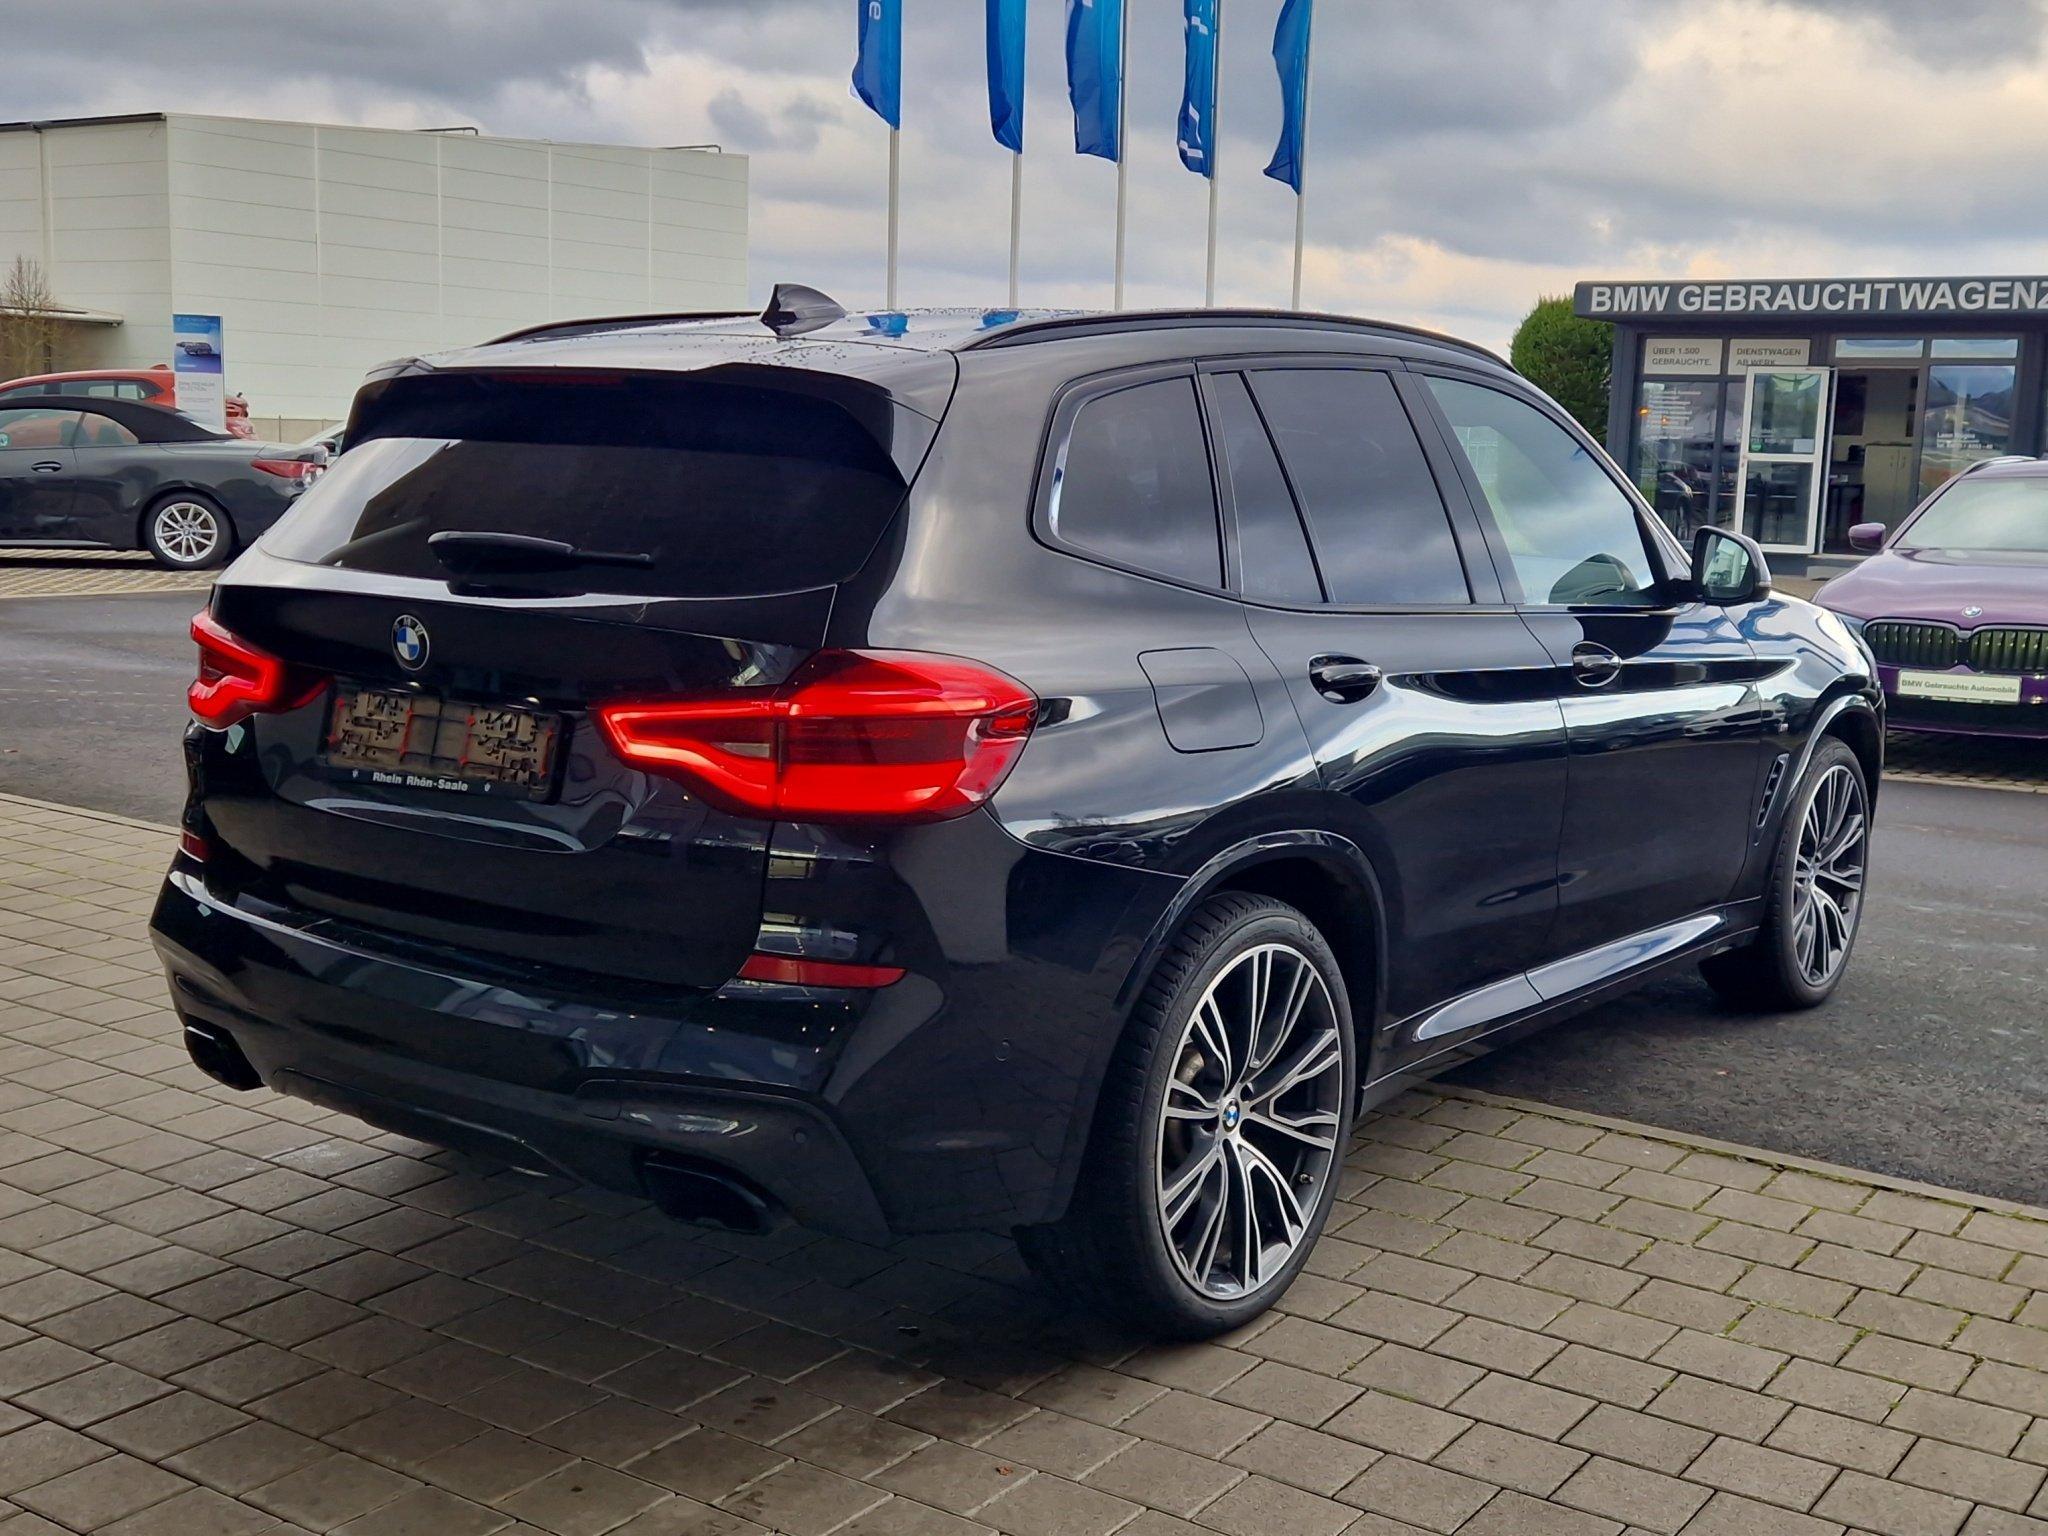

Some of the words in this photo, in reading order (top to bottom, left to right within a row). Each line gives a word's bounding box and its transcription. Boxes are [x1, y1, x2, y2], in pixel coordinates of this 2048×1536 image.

[1590, 286, 1671, 312] BMW
[1653, 346, 1675, 355] ÜBER
[1678, 347, 1700, 355] 1.500
[1736, 348, 1801, 356] DIENSTWAGEN
[1901, 679, 1924, 688] BMW
[1924, 681, 1970, 691] Gebrauchte
[1970, 684, 2017, 694] Automobile
[372, 772, 402, 784] Rhein
